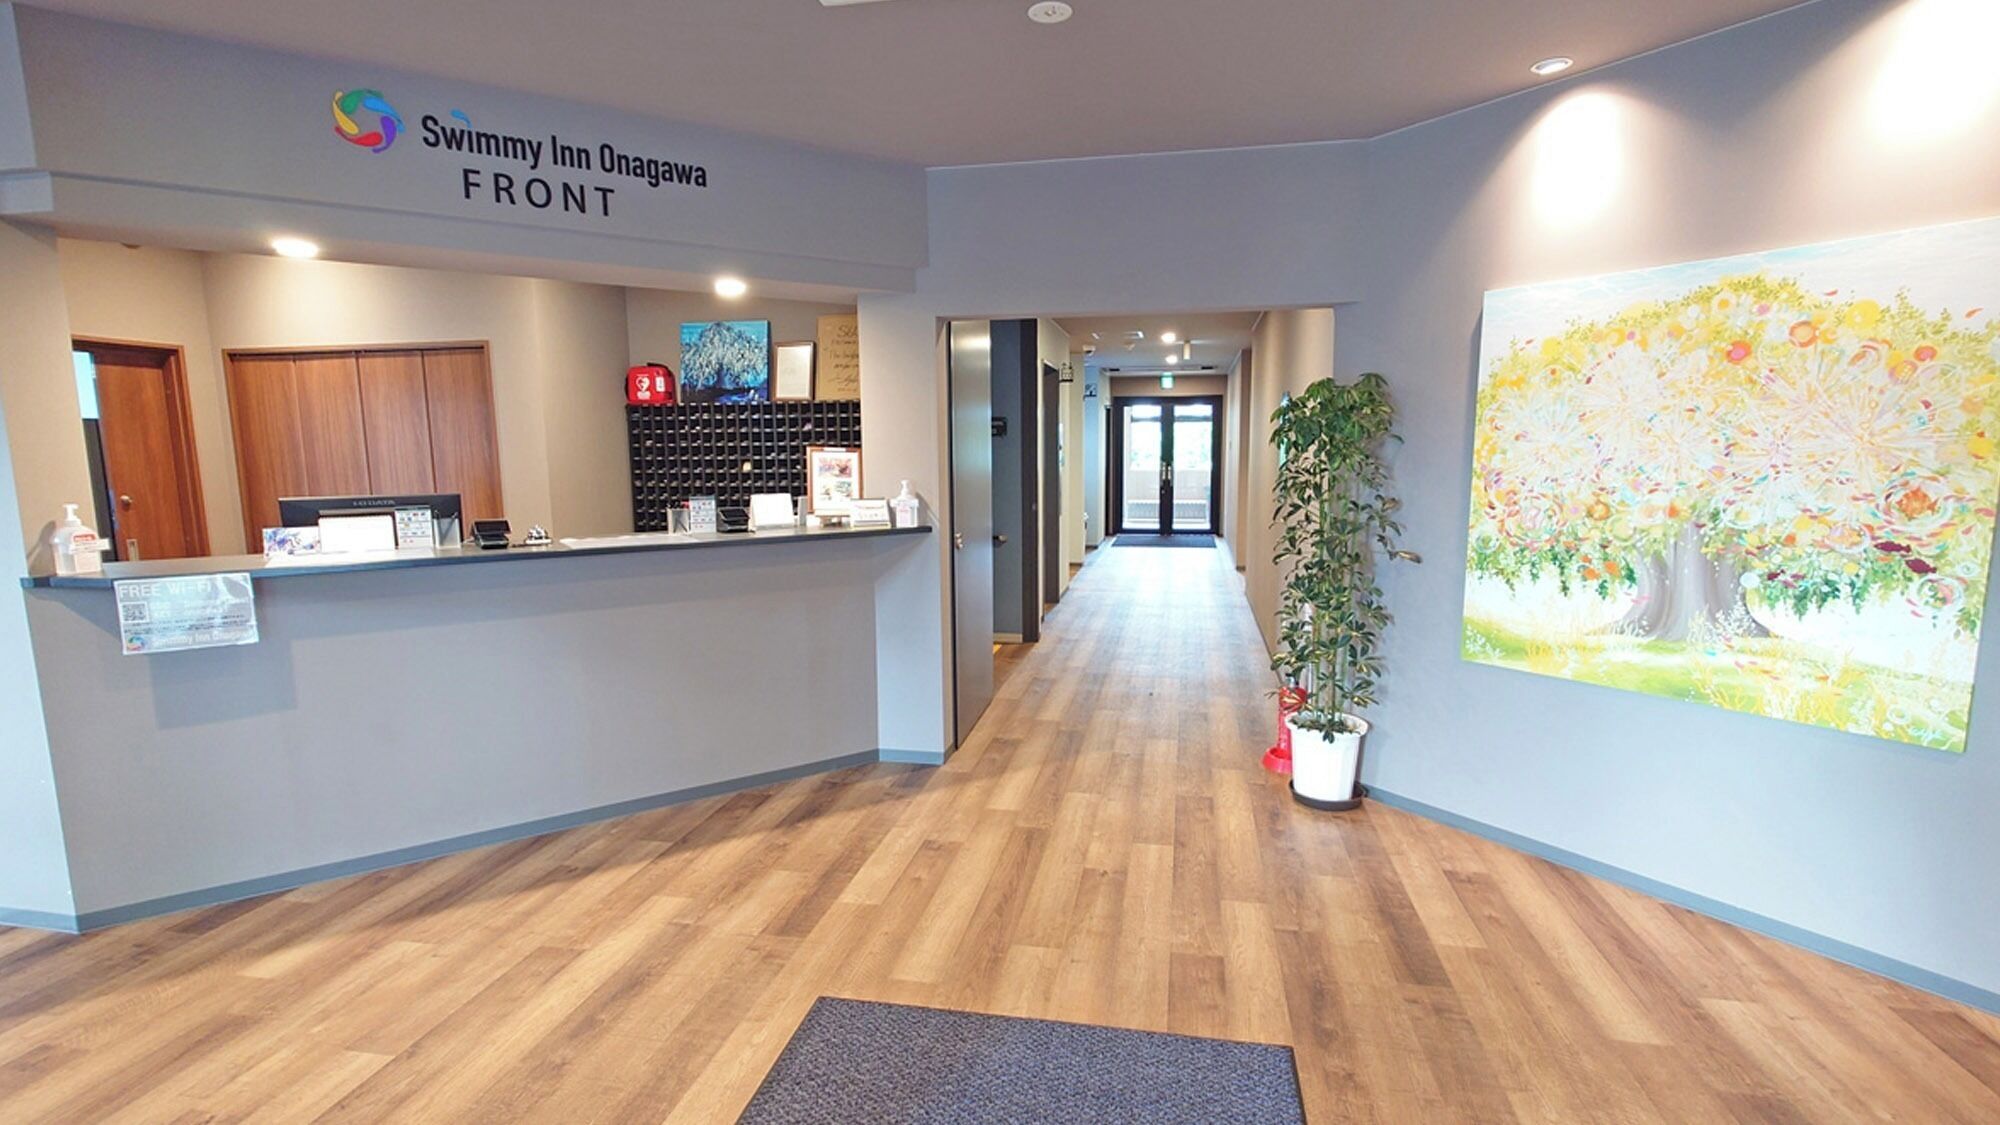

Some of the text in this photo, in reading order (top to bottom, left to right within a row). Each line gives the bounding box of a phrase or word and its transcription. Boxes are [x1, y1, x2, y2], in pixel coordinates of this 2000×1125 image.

[421, 114, 707, 188] Swimmy Inn Onagawa
[462, 168, 615, 217] FRONT
[119, 582, 162, 598] FREE
